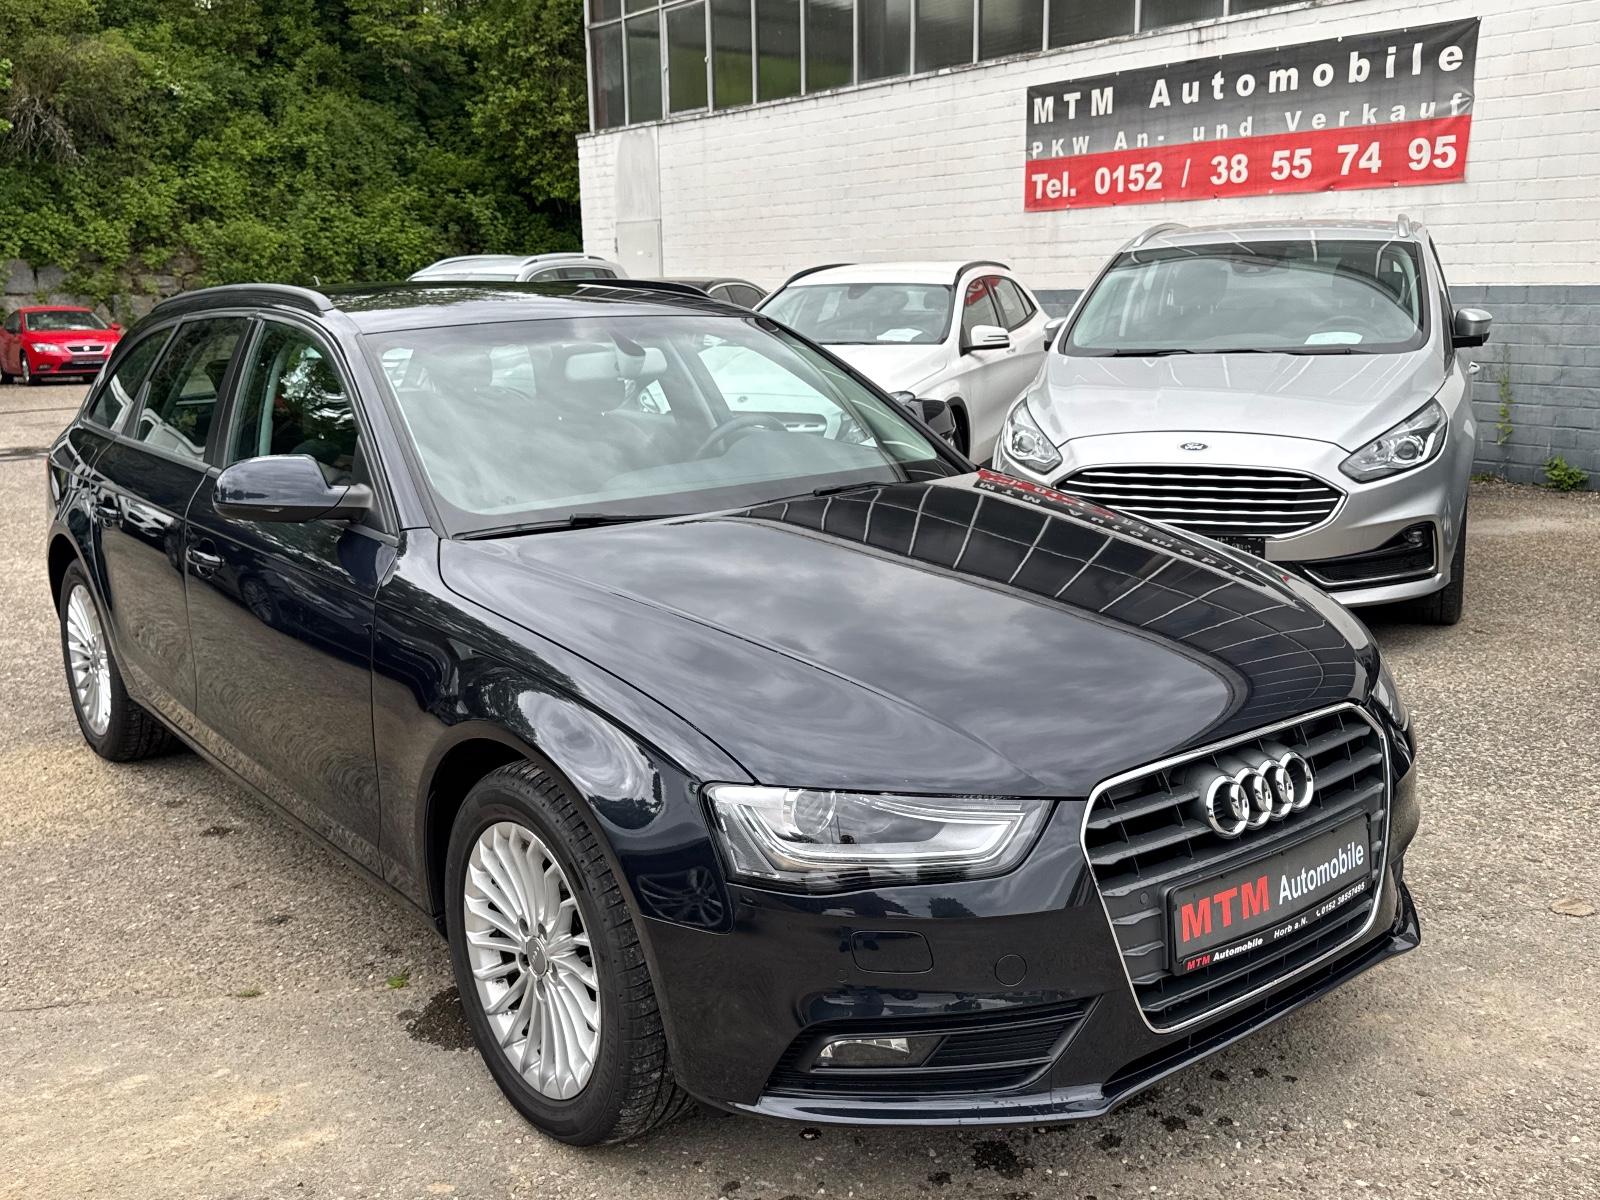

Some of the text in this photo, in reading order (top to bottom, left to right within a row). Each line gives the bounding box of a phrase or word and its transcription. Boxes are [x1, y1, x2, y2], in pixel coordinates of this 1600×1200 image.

[1033, 43, 1465, 125] MTM Automobile
[1031, 92, 1462, 160] PKW An- und Verkauf
[1032, 135, 1457, 201] Tel. 0152 / 38 55 74 95
[1181, 841, 1364, 943] MTM Automobile
[1186, 955, 1211, 971] MTM
[1213, 938, 1264, 961] Automobile
[1274, 924, 1293, 939] Horb
[1321, 900, 1336, 915] 0152
